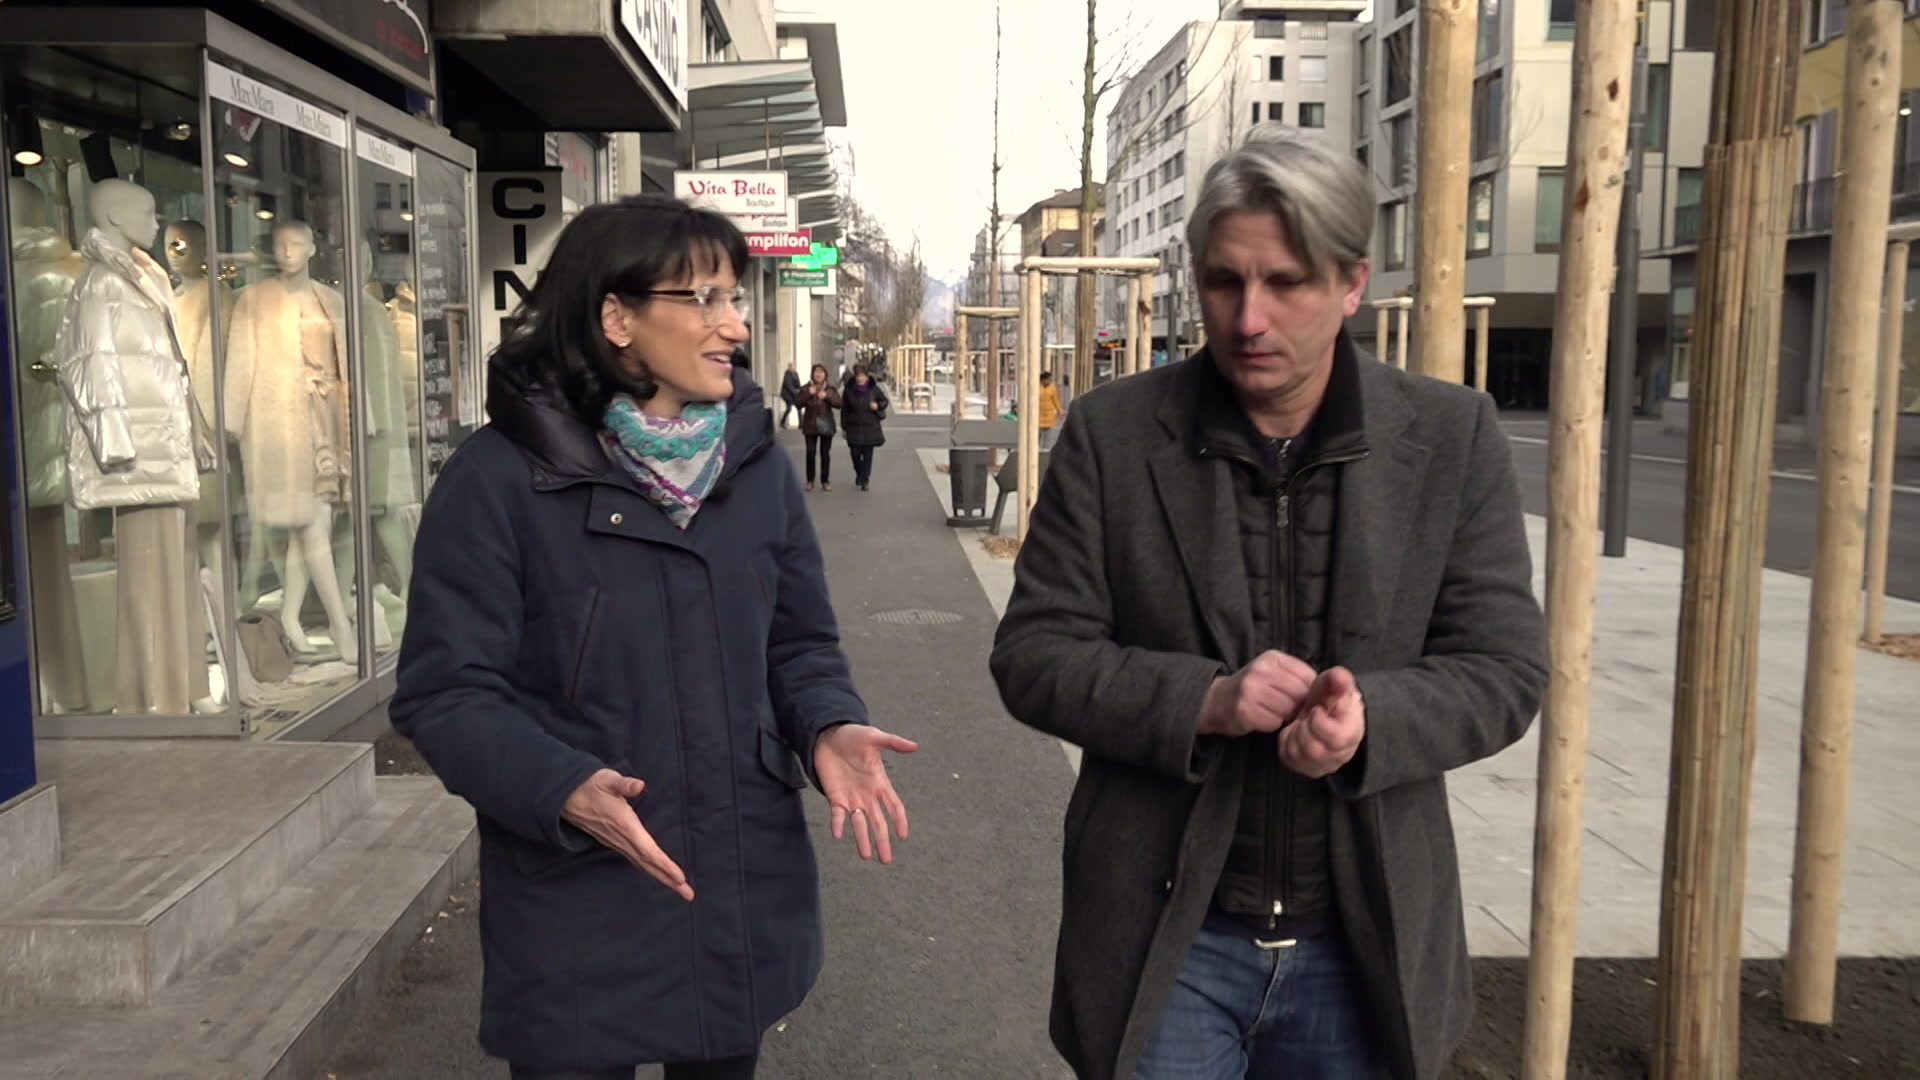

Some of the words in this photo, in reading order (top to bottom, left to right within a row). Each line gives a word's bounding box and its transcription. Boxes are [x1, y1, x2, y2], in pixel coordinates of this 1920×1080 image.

[688, 180, 728, 196] Vita
[731, 179, 776, 197] Bella
[745, 233, 809, 251] mplifon
[491, 177, 546, 340] CIN
